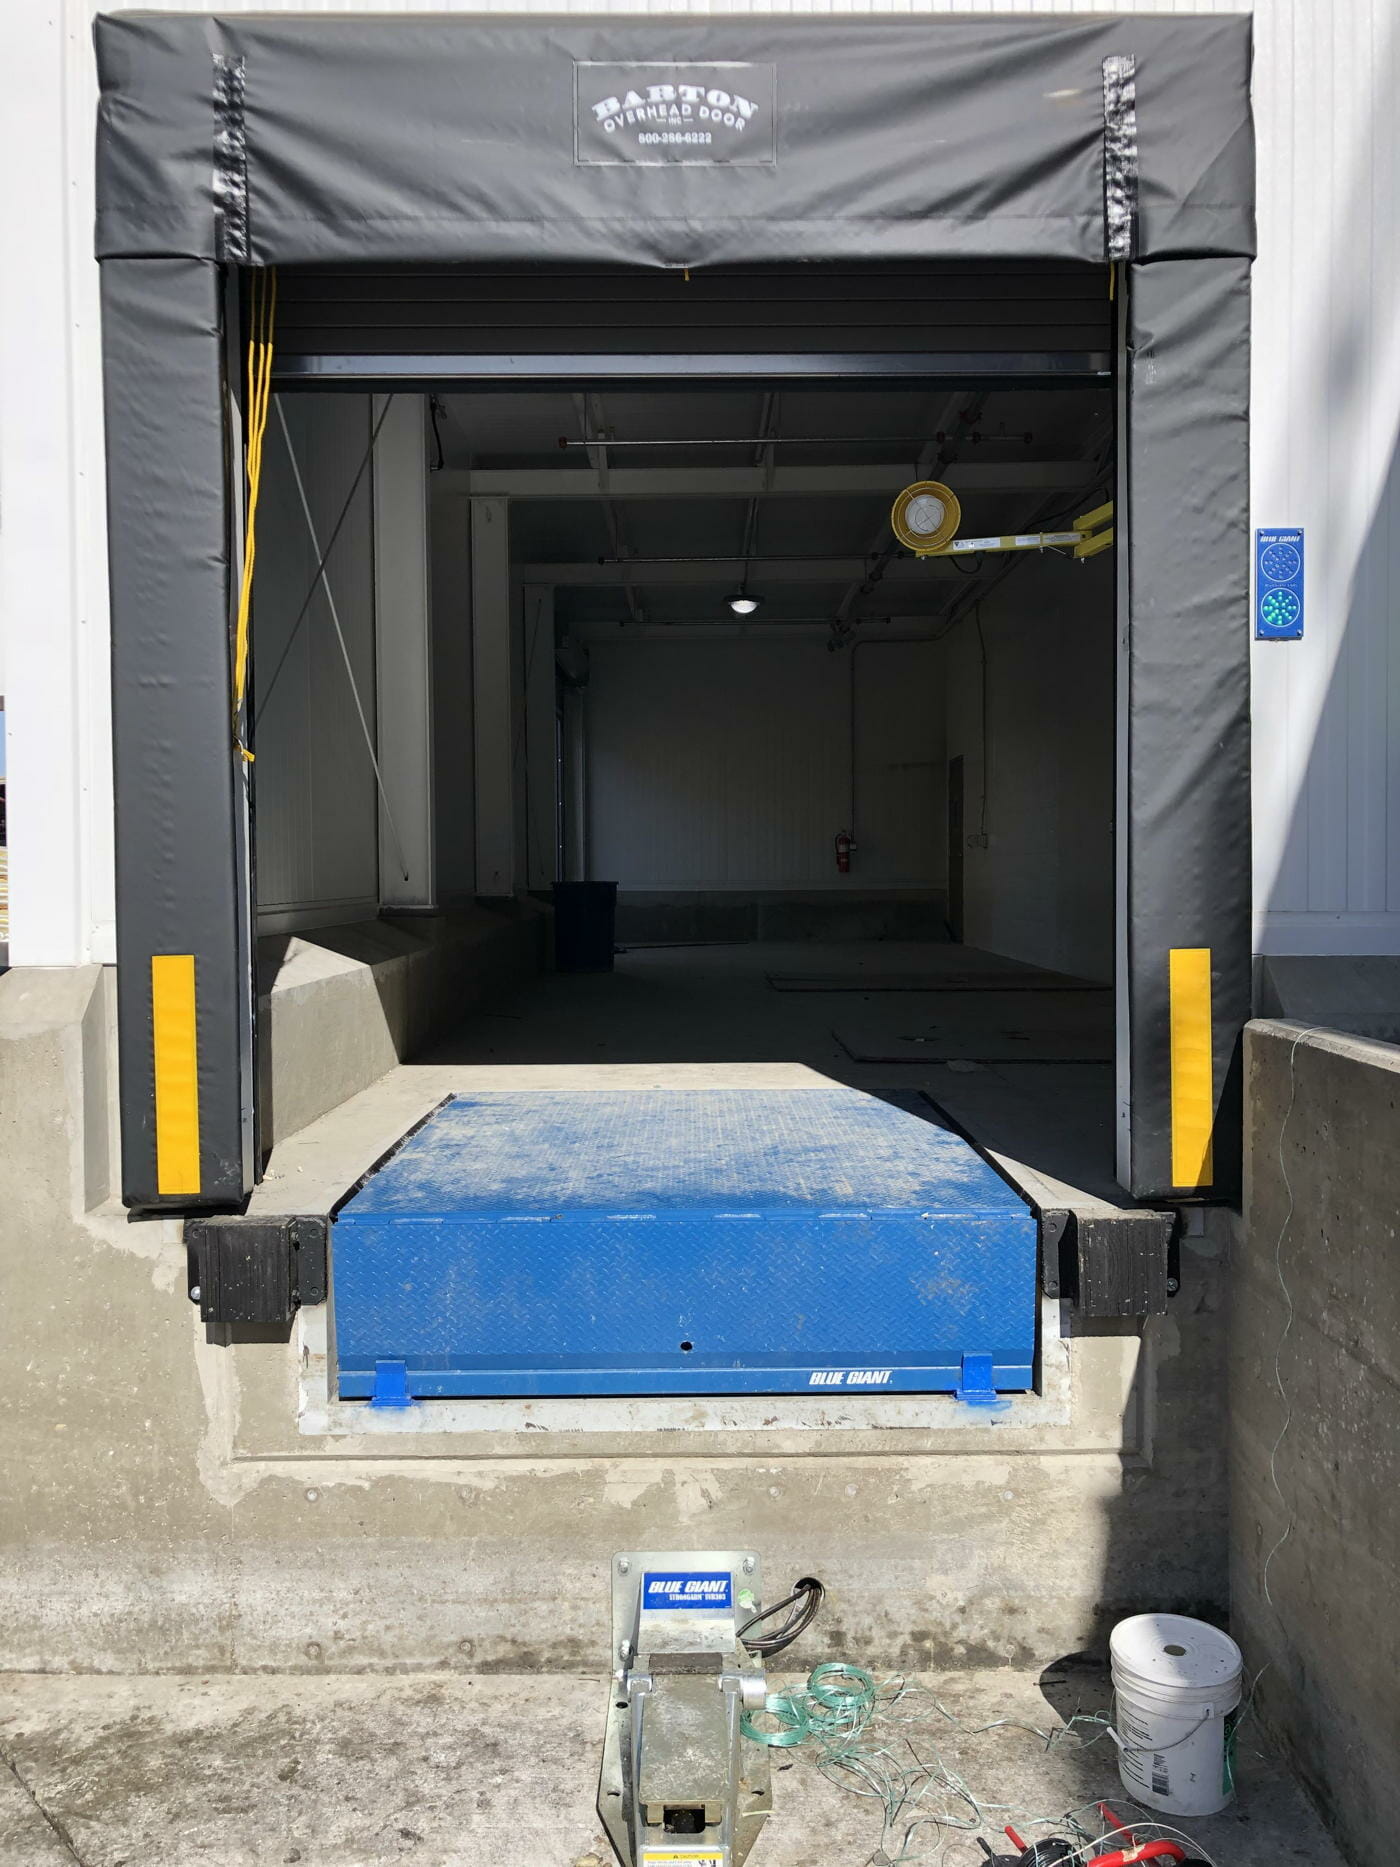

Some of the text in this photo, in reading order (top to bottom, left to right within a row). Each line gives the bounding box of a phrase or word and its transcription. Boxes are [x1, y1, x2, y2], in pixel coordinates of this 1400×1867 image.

[592, 84, 759, 120] BARTON
[603, 104, 746, 133] OVERHEAD DOOR
[809, 1370, 893, 1385] BLUE GIANT
[648, 1580, 729, 1593] BLUE GIANT
